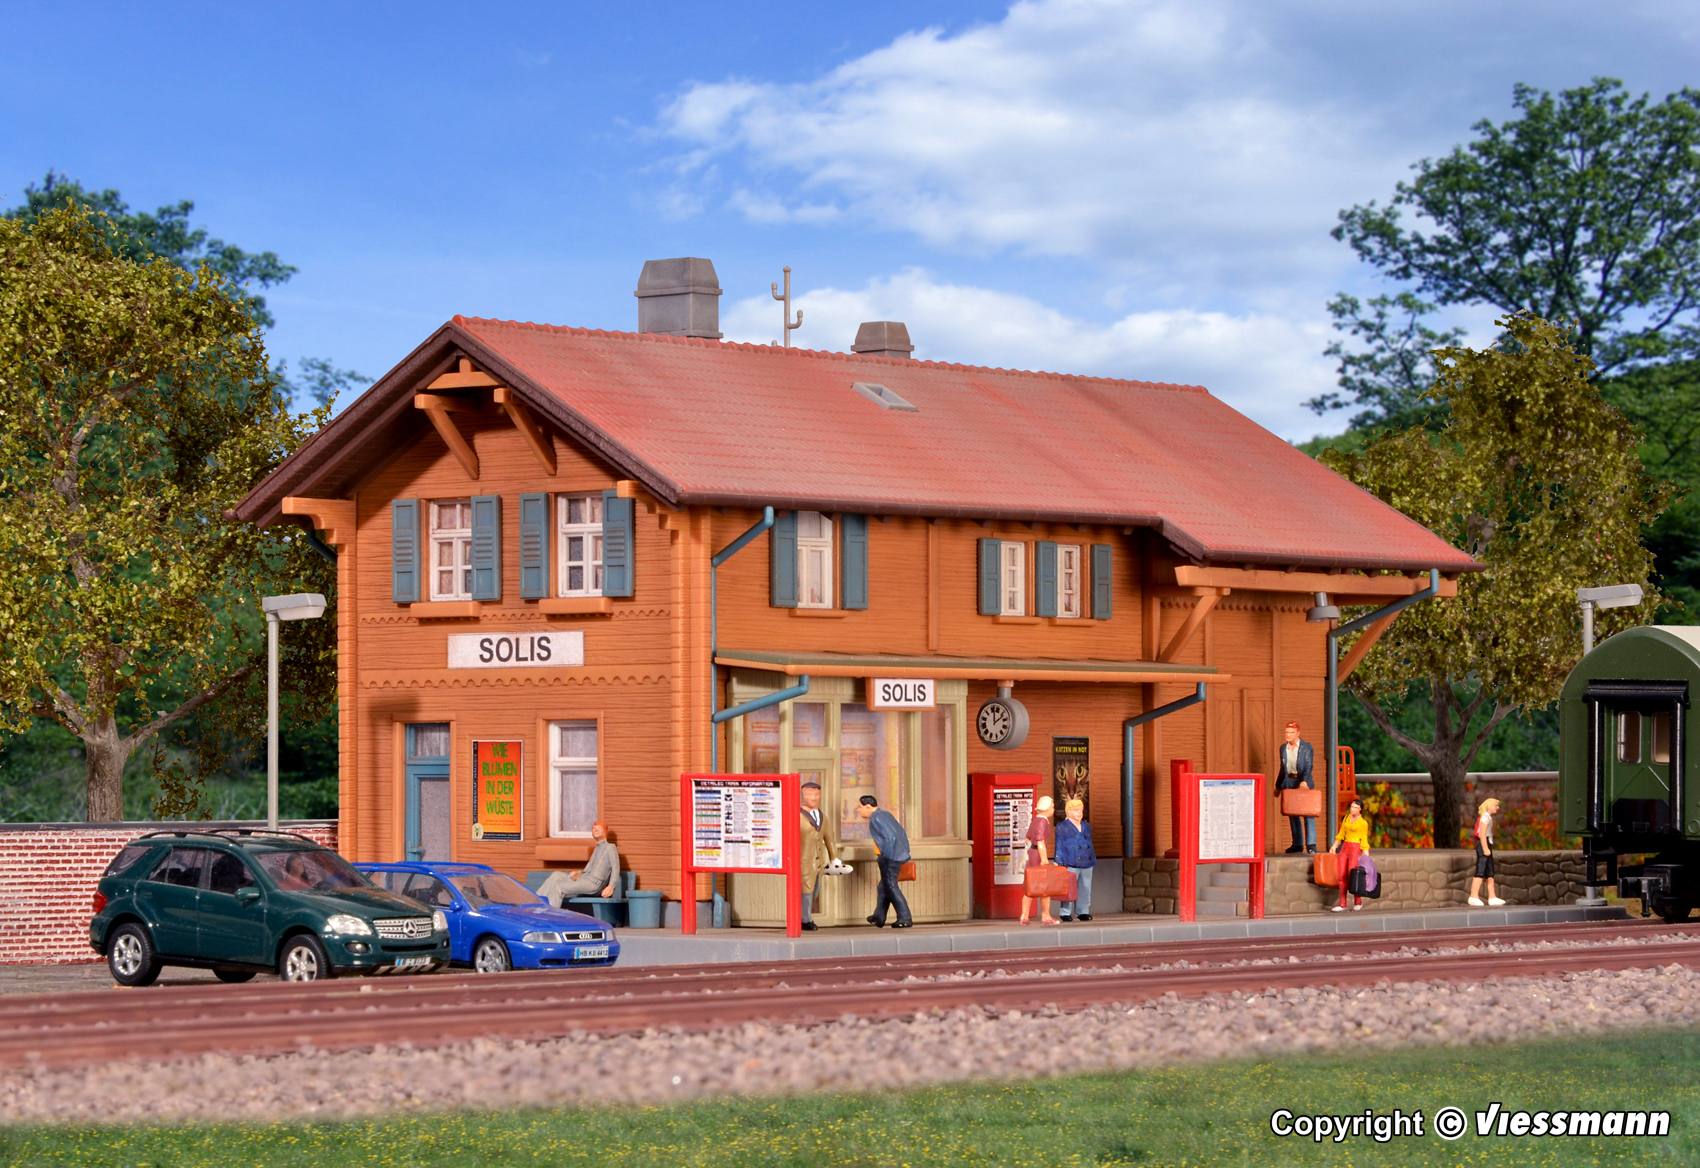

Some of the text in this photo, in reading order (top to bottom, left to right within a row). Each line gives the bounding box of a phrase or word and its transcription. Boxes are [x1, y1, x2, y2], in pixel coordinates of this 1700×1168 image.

[479, 635, 552, 663] SOLIS
[882, 683, 927, 702] SOLIS
[491, 743, 508, 758] WIE
[482, 761, 517, 776] BLUMEN
[485, 780, 514, 795] IN DER
[485, 796, 514, 815] WÜSTE
